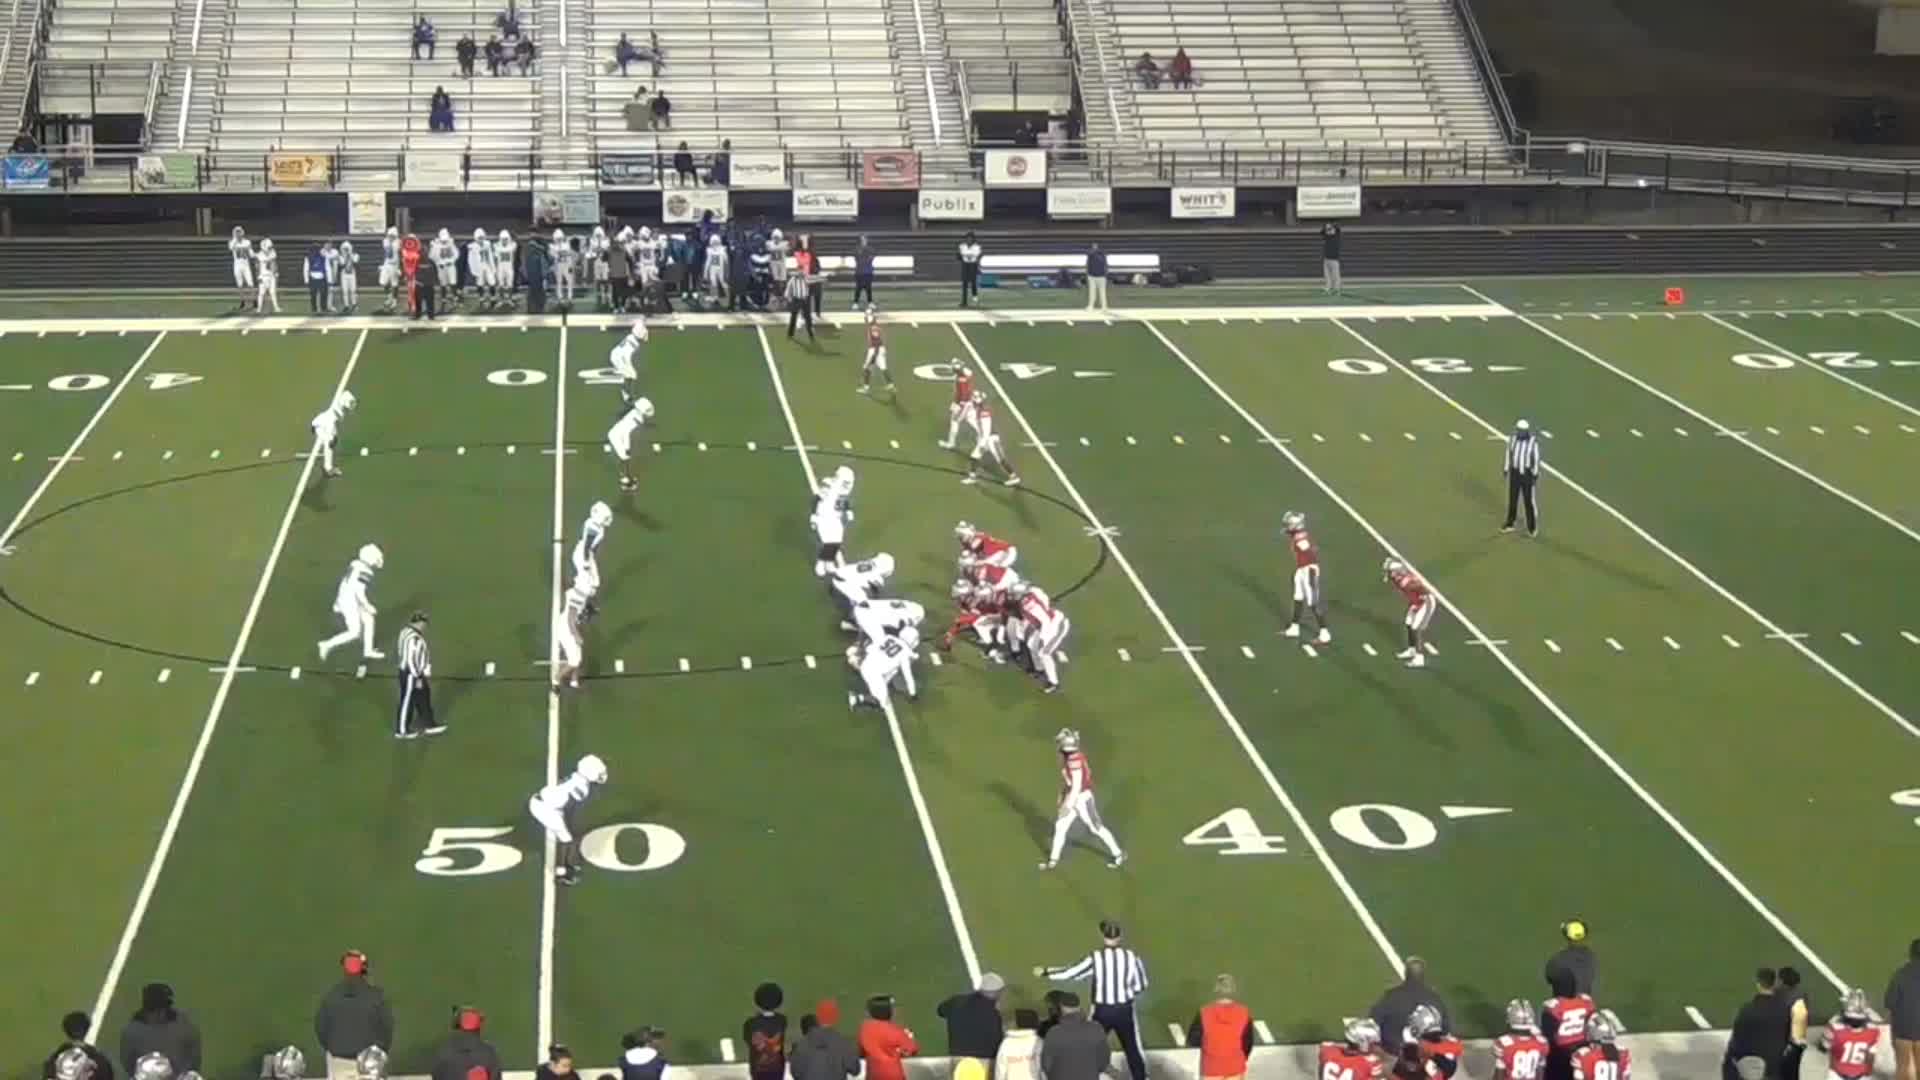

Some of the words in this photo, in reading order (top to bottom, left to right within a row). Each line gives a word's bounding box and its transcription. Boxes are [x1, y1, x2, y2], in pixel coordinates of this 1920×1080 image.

[922, 198, 976, 211] Publix
[1182, 803, 1438, 855] 40
[415, 823, 687, 877] 50
[1558, 1007, 1586, 1037] 25
[1511, 1049, 1541, 1080] 80
[1840, 1041, 1867, 1065] 16
